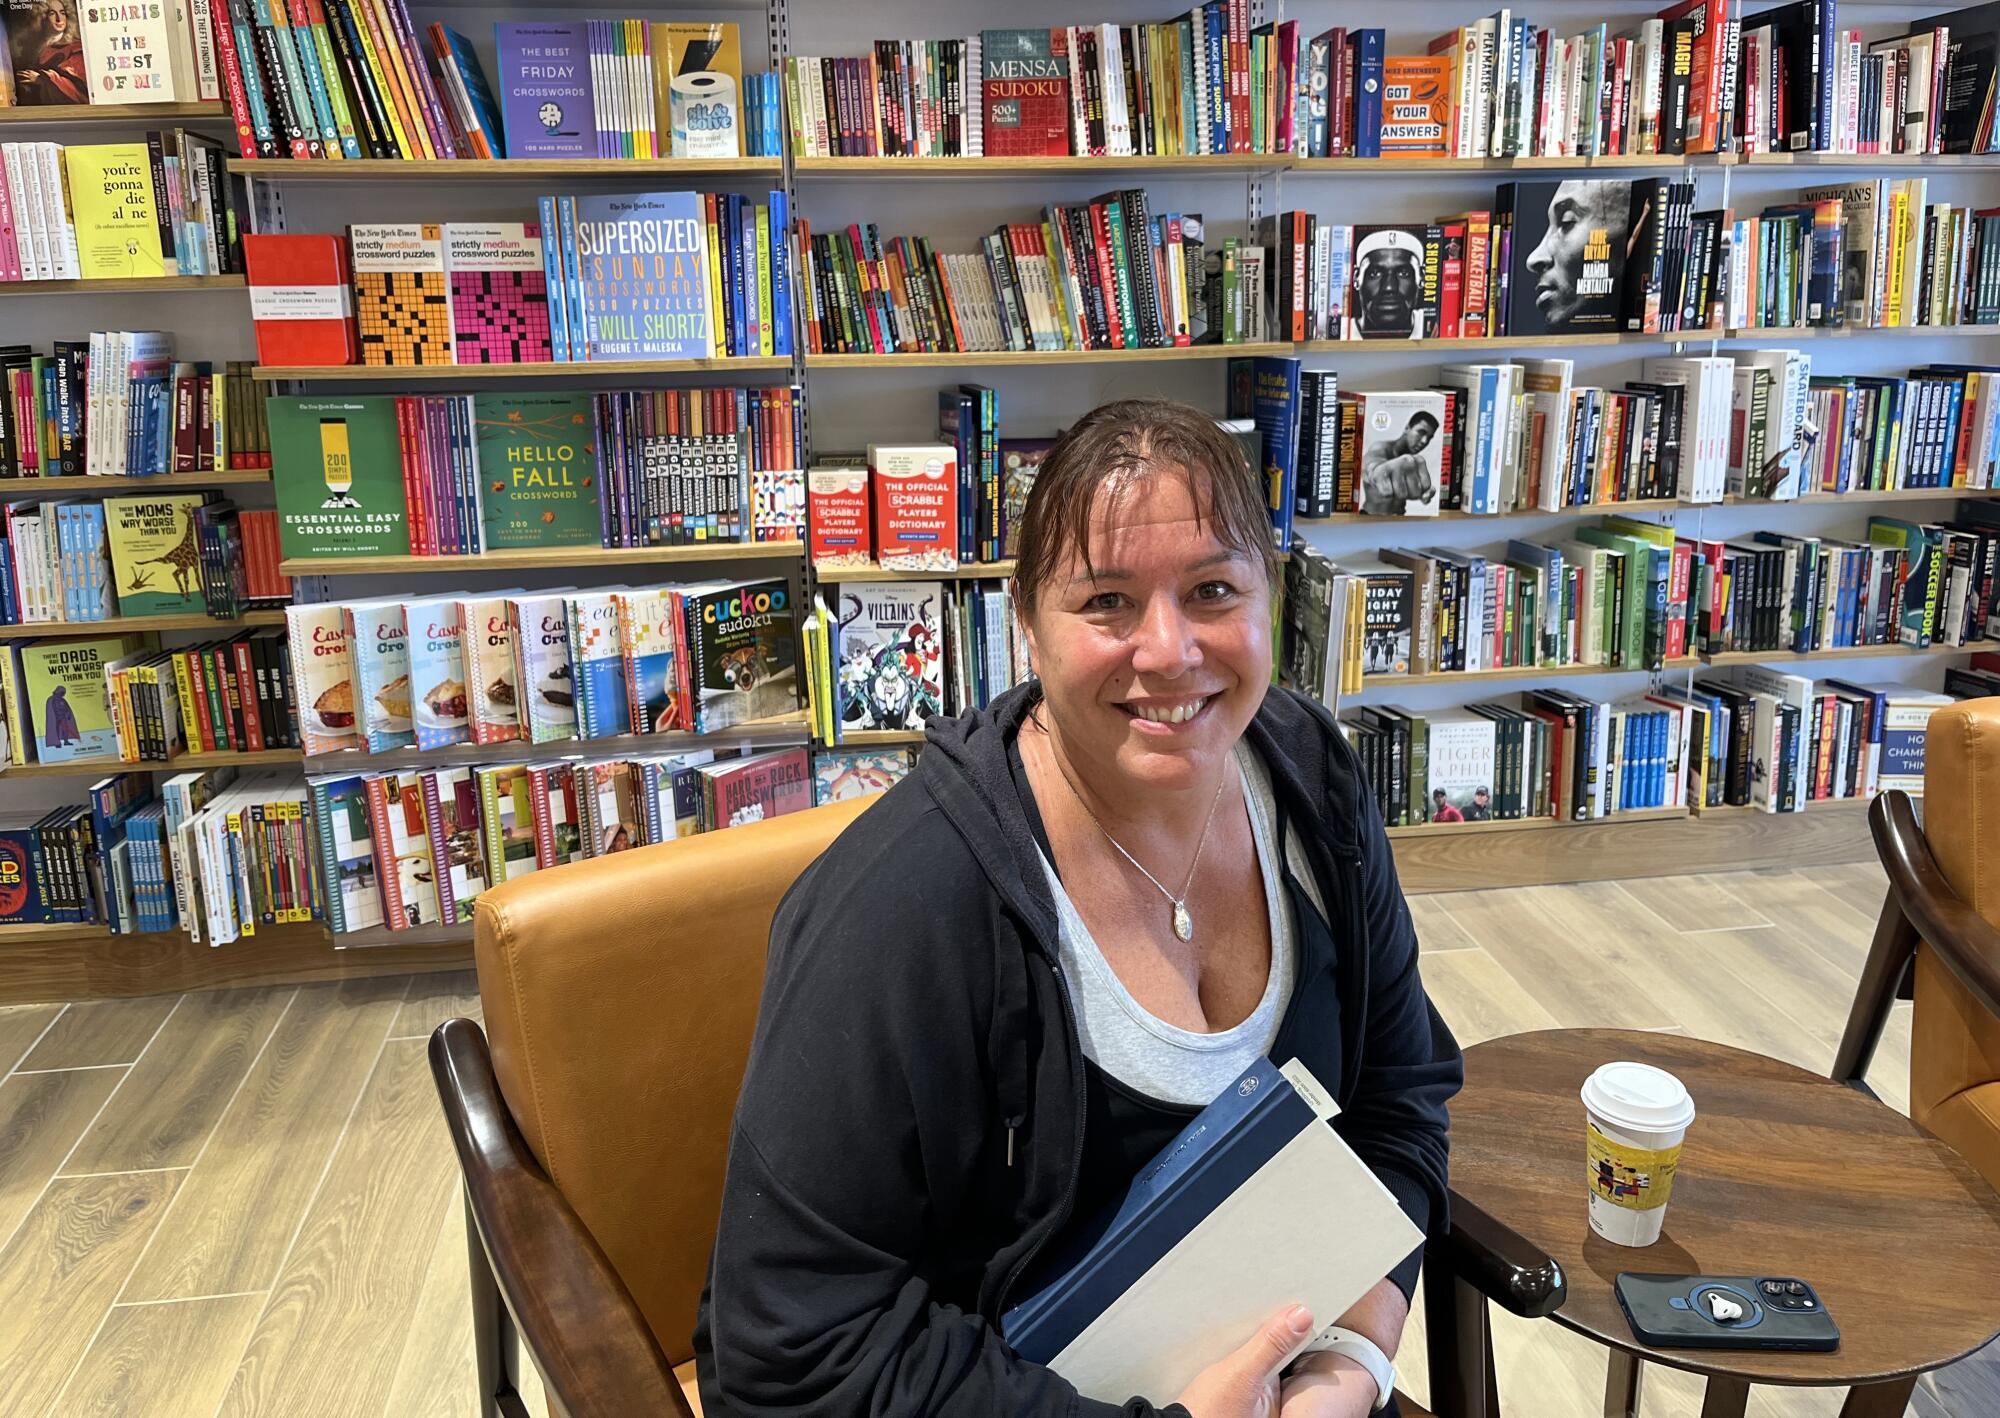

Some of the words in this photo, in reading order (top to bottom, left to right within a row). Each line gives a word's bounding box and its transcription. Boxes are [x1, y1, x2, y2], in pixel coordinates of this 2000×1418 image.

[88, 4, 160, 23] SEDARIS
[199, 18, 207, 39] THEFT
[219, 22, 230, 47] Large
[110, 36, 146, 50] THE
[1212, 38, 1220, 62] LARGE
[1727, 22, 1740, 62] HOOP
[202, 48, 211, 74] FINDING
[225, 48, 236, 69] Print
[522, 48, 542, 56] THE
[545, 48, 570, 56] BEST
[1511, 26, 1522, 83] BALLPARK
[1674, 32, 1691, 76] MAGIC
[107, 54, 152, 70] BEST
[990, 60, 1061, 78] MENSA
[1481, 32, 1494, 94] PLAYMAKERS
[522, 67, 574, 78] FRIDAY
[103, 76, 126, 90] OF
[134, 74, 161, 89] ME
[990, 82, 1062, 98] SUDOKU
[1724, 64, 1736, 110] ATLAS
[229, 67, 245, 122] CROSSWORDS
[513, 88, 585, 97] CROSSWORDS
[1386, 87, 1408, 98] GOT
[992, 105, 1017, 116] 500+
[1214, 86, 1222, 123] SUDOKU
[1396, 106, 1426, 118] YOUR
[688, 115, 732, 131] solve
[992, 116, 1017, 124] Puzzles
[1224, 102, 1232, 132] SUDOKU
[1382, 125, 1440, 137] ANSWERS
[102, 162, 141, 180] you're
[198, 163, 208, 192] IDIOT
[104, 180, 144, 194] gonna
[1806, 187, 1871, 202] MICHIGAN'S
[126, 192, 145, 204] die
[356, 240, 384, 250] strictly
[451, 240, 481, 250] strictly
[484, 240, 520, 248] medium
[579, 219, 700, 255] SUPERSIZED
[744, 228, 754, 250] Large
[758, 228, 767, 248] Large
[356, 250, 400, 258] crossword
[403, 251, 436, 260] puzzles
[452, 250, 499, 258] crossword
[502, 250, 535, 259] puzzles
[1584, 244, 1611, 260] BRYANT
[594, 256, 702, 280] SUNDAY
[747, 252, 755, 272] Print
[760, 252, 768, 271] Print
[1332, 252, 1341, 289] GIANNIS
[1583, 263, 1609, 278] MAMBA
[1113, 223, 1122, 246] LARGE
[1118, 268, 1133, 329] CRYPTOGRAMS
[1294, 244, 1304, 311] DYNASTIES
[1424, 242, 1438, 302] SHOWBOAT
[1468, 236, 1486, 308] BASKETBALL
[588, 280, 702, 296] CROSSWORDS
[1576, 279, 1614, 294] MENTALITY
[590, 299, 616, 311] 500
[633, 298, 702, 310] PUZZLES
[748, 274, 756, 320] CROSSWORDS
[599, 315, 639, 340] WILL
[644, 314, 706, 340] SHORTZ
[601, 343, 632, 354] EUGENE
[634, 343, 640, 353] T.
[644, 342, 682, 352] MALESKA
[58, 359, 66, 376] Man
[59, 379, 68, 404] Walks
[1323, 376, 1337, 414] ARNOLD
[1752, 373, 1768, 424] SURVIVAL
[60, 406, 68, 424] into
[1444, 395, 1456, 434] IRON
[1652, 403, 1661, 422] TIM
[1792, 363, 1808, 450] SKATEBOARD
[1342, 406, 1356, 430] MIKE
[62, 433, 71, 450] BAR
[1340, 433, 1355, 461] TYSON
[1649, 426, 1660, 462] TEBOW
[327, 454, 347, 466] 200
[507, 446, 574, 462] HELLO
[646, 438, 655, 476] MEGA
[658, 436, 666, 474] MEGA
[1318, 416, 1334, 500] SCHWARZENEGGER
[1440, 446, 1452, 485] MIKE
[512, 467, 574, 488] FALL
[510, 490, 578, 500] CROSSWORDS
[906, 483, 948, 491] OFFICIAL
[892, 496, 943, 505] SCRABBLE
[135, 504, 174, 517] MOMS
[286, 514, 360, 524] ESSENTIAL
[367, 514, 400, 522] EASY
[820, 508, 860, 516] SCRABBLE
[120, 520, 141, 528] WAY
[143, 518, 175, 527] WORSE
[139, 528, 160, 536] THAN
[298, 525, 392, 534] CROSSWORDS
[1984, 540, 1996, 574] ROUSEY
[1550, 559, 1560, 592] DRIVE
[1636, 564, 1644, 586] THE
[1926, 552, 1942, 599] SOCCER
[1420, 583, 1430, 600] The
[704, 588, 785, 624] cuckoo
[868, 603, 916, 622] VILLAINS
[1368, 601, 1398, 610] IGHT
[1482, 587, 1496, 636] LEAGUE
[719, 614, 772, 634] sudoku
[1366, 614, 1400, 623] GHTS
[1418, 602, 1430, 640] Football
[1922, 602, 1936, 636] BOOK
[426, 624, 459, 640] Easy
[1632, 620, 1641, 653] BOOK
[427, 640, 459, 652] Cros
[1418, 641, 1427, 659] 100
[60, 648, 98, 664] DADS
[190, 655, 201, 670] DAD
[48, 665, 69, 675] WAY
[176, 660, 186, 674] ALL
[62, 674, 83, 682] THAN
[178, 675, 188, 692] NEW
[192, 670, 203, 692] JOKES
[1908, 734, 1925, 744] HO
[1435, 747, 1490, 762] TIGER
[1818, 710, 1834, 788] ROWDY
[1435, 767, 1444, 777] &
[1449, 764, 1491, 777] PHIL
[726, 778, 750, 798] HARD
[770, 762, 801, 784] ROCK
